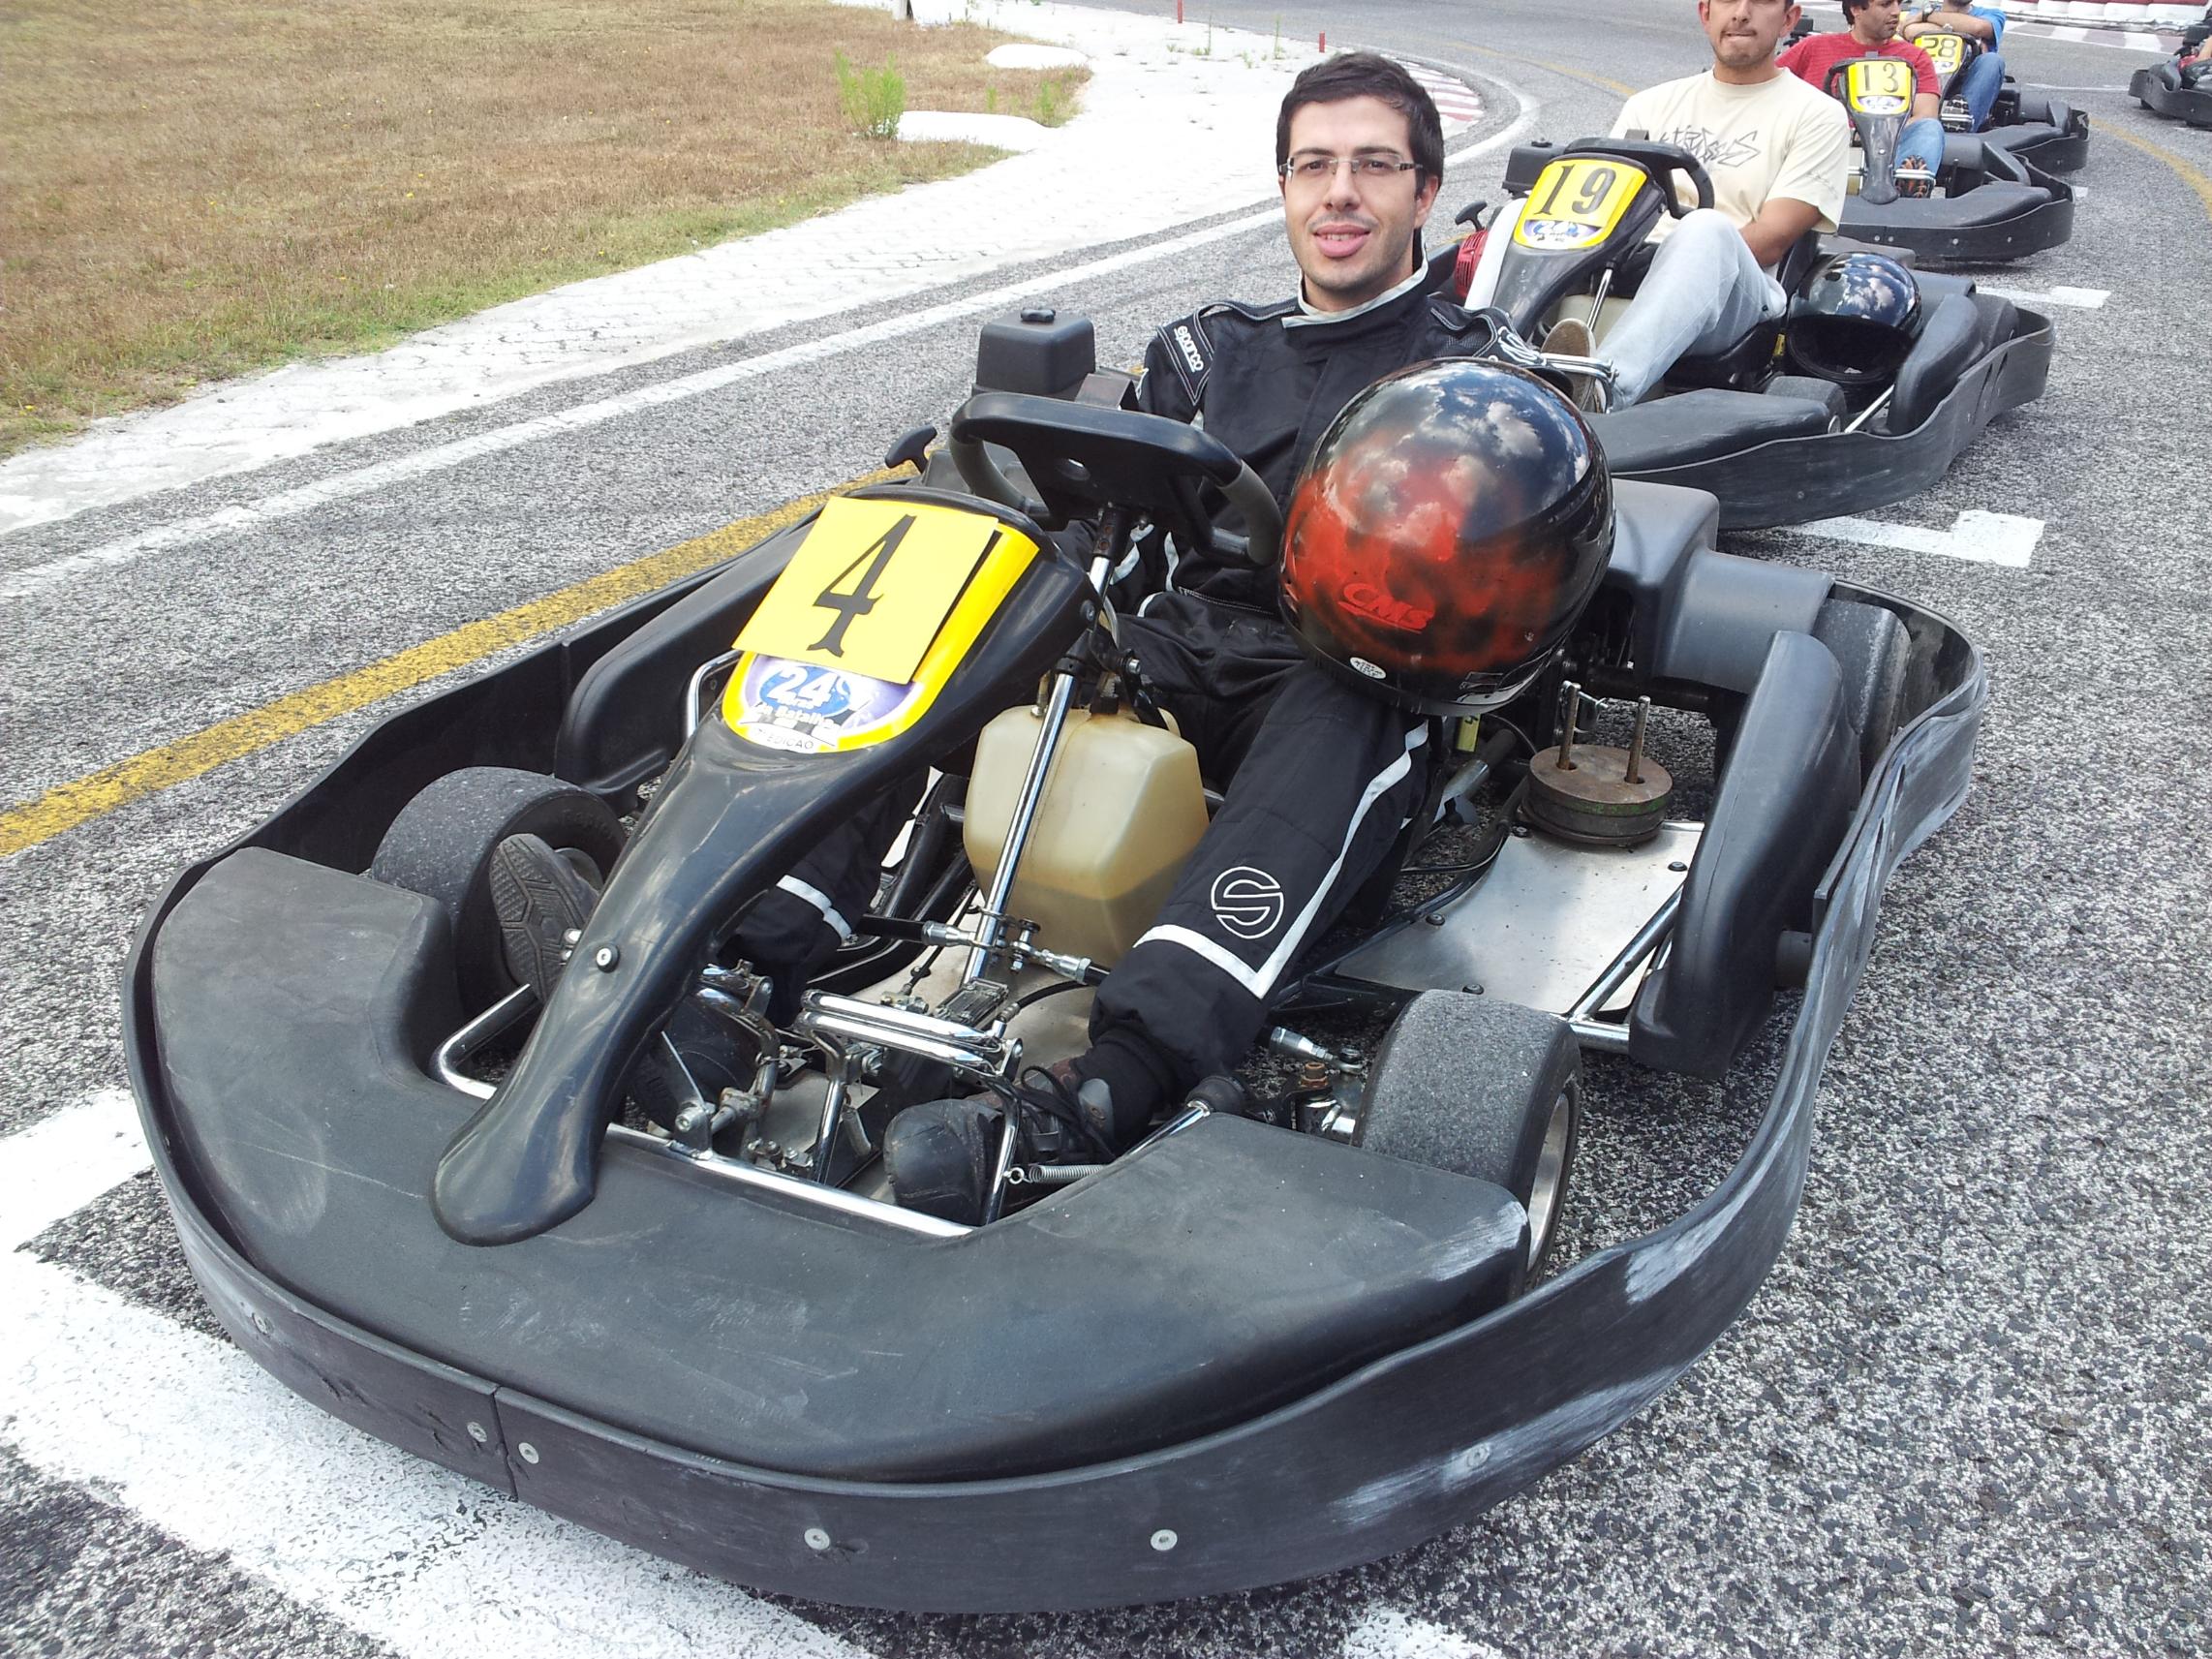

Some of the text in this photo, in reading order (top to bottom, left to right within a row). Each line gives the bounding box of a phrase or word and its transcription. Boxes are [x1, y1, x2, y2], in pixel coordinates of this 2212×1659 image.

[1922, 37, 1957, 58] 28
[1863, 62, 1899, 93] 13
[1533, 164, 1617, 215] 19
[806, 513, 917, 658] 4
